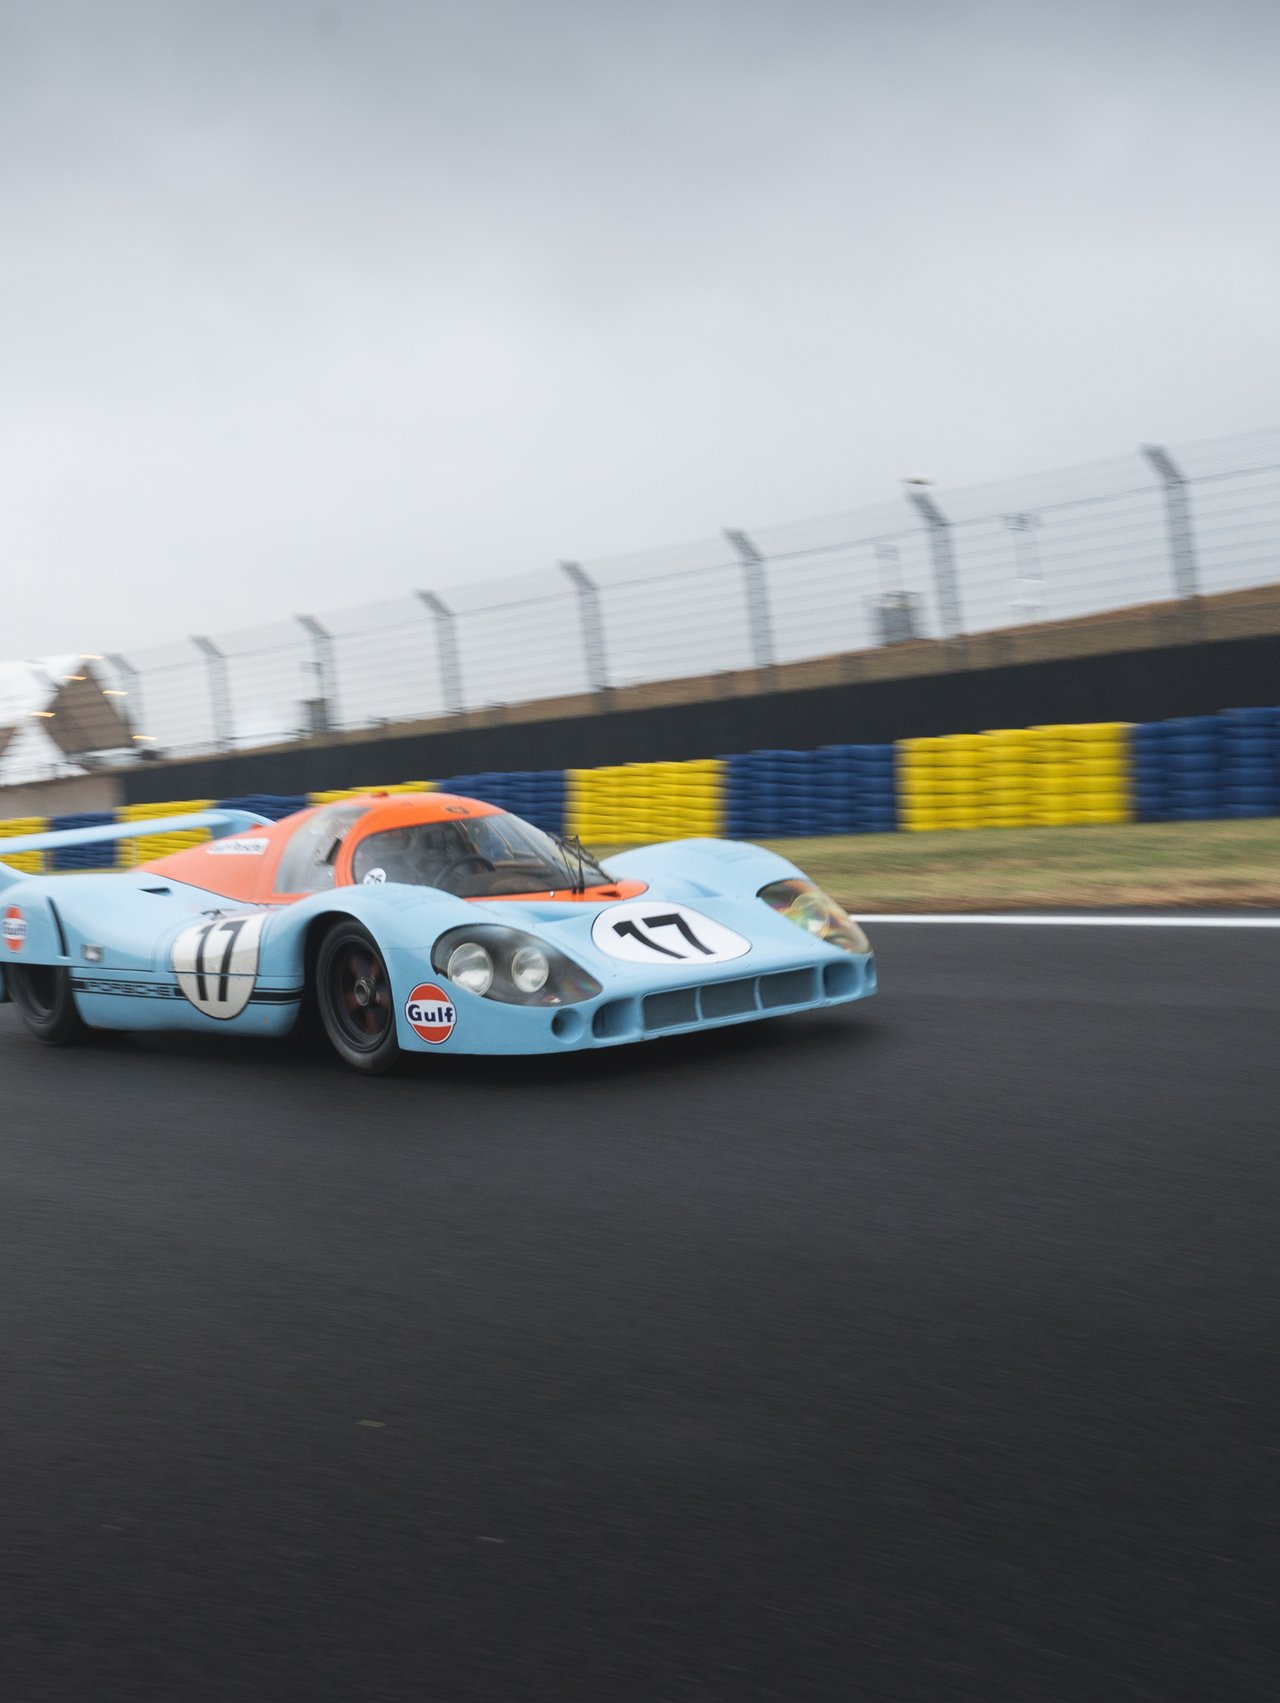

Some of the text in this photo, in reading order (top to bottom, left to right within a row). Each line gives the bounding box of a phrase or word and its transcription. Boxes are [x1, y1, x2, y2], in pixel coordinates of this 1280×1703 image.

[612, 912, 715, 959] 17
[196, 919, 248, 1003] 17
[407, 1003, 453, 1022] Gulf
